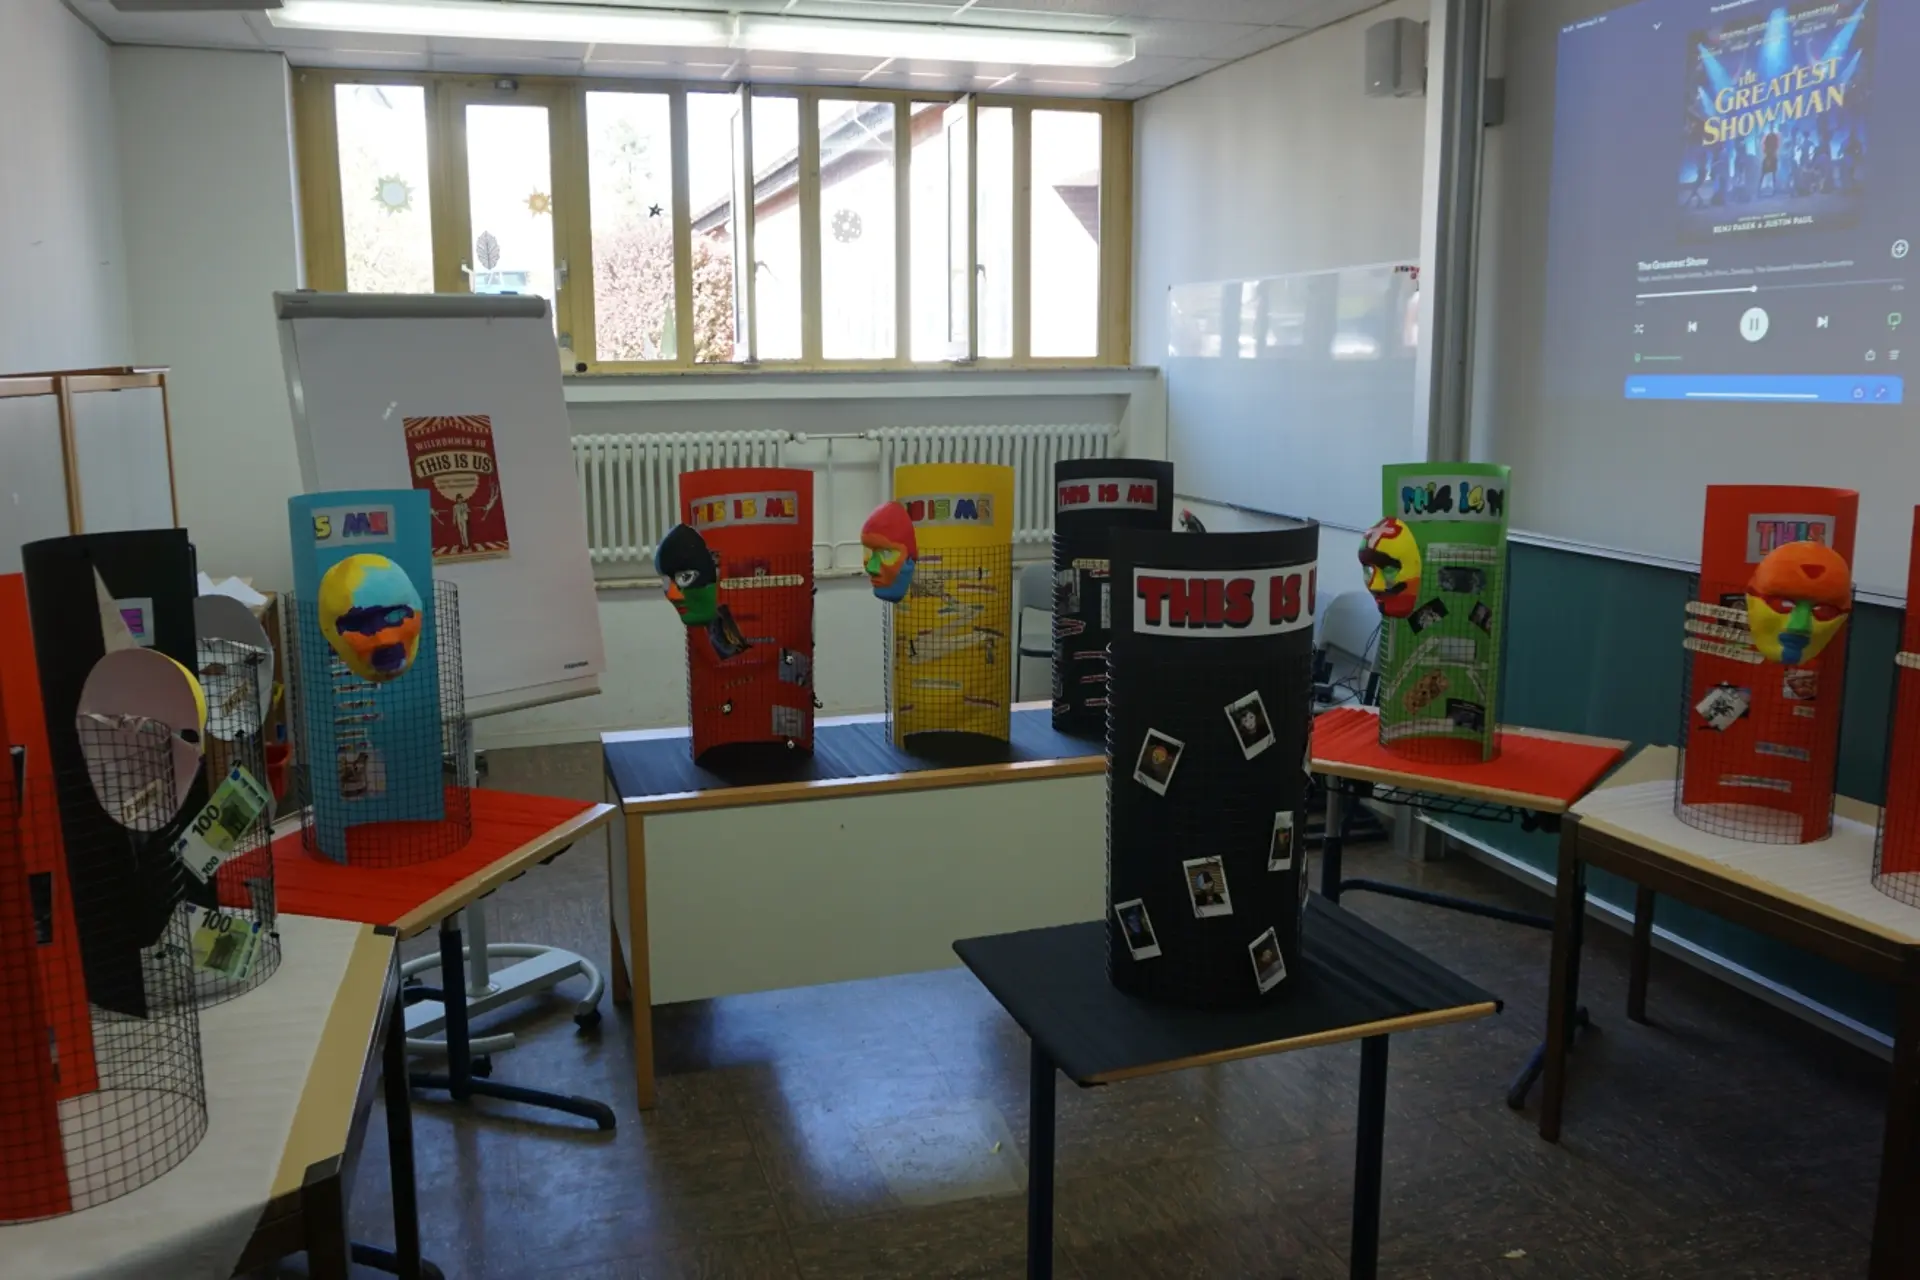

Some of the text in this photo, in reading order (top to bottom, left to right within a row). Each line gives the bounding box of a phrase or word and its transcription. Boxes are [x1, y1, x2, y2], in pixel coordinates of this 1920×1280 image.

[1714, 57, 1844, 115] GREATEST
[1702, 83, 1847, 147] SHOWMAN
[416, 453, 492, 477] THIS IS US
[1756, 520, 1826, 556] THIS
[1136, 575, 1255, 629] THIS
[1269, 573, 1302, 625] IS
[191, 804, 221, 837] 100
[201, 856, 220, 876] 100
[201, 909, 232, 933] 100
